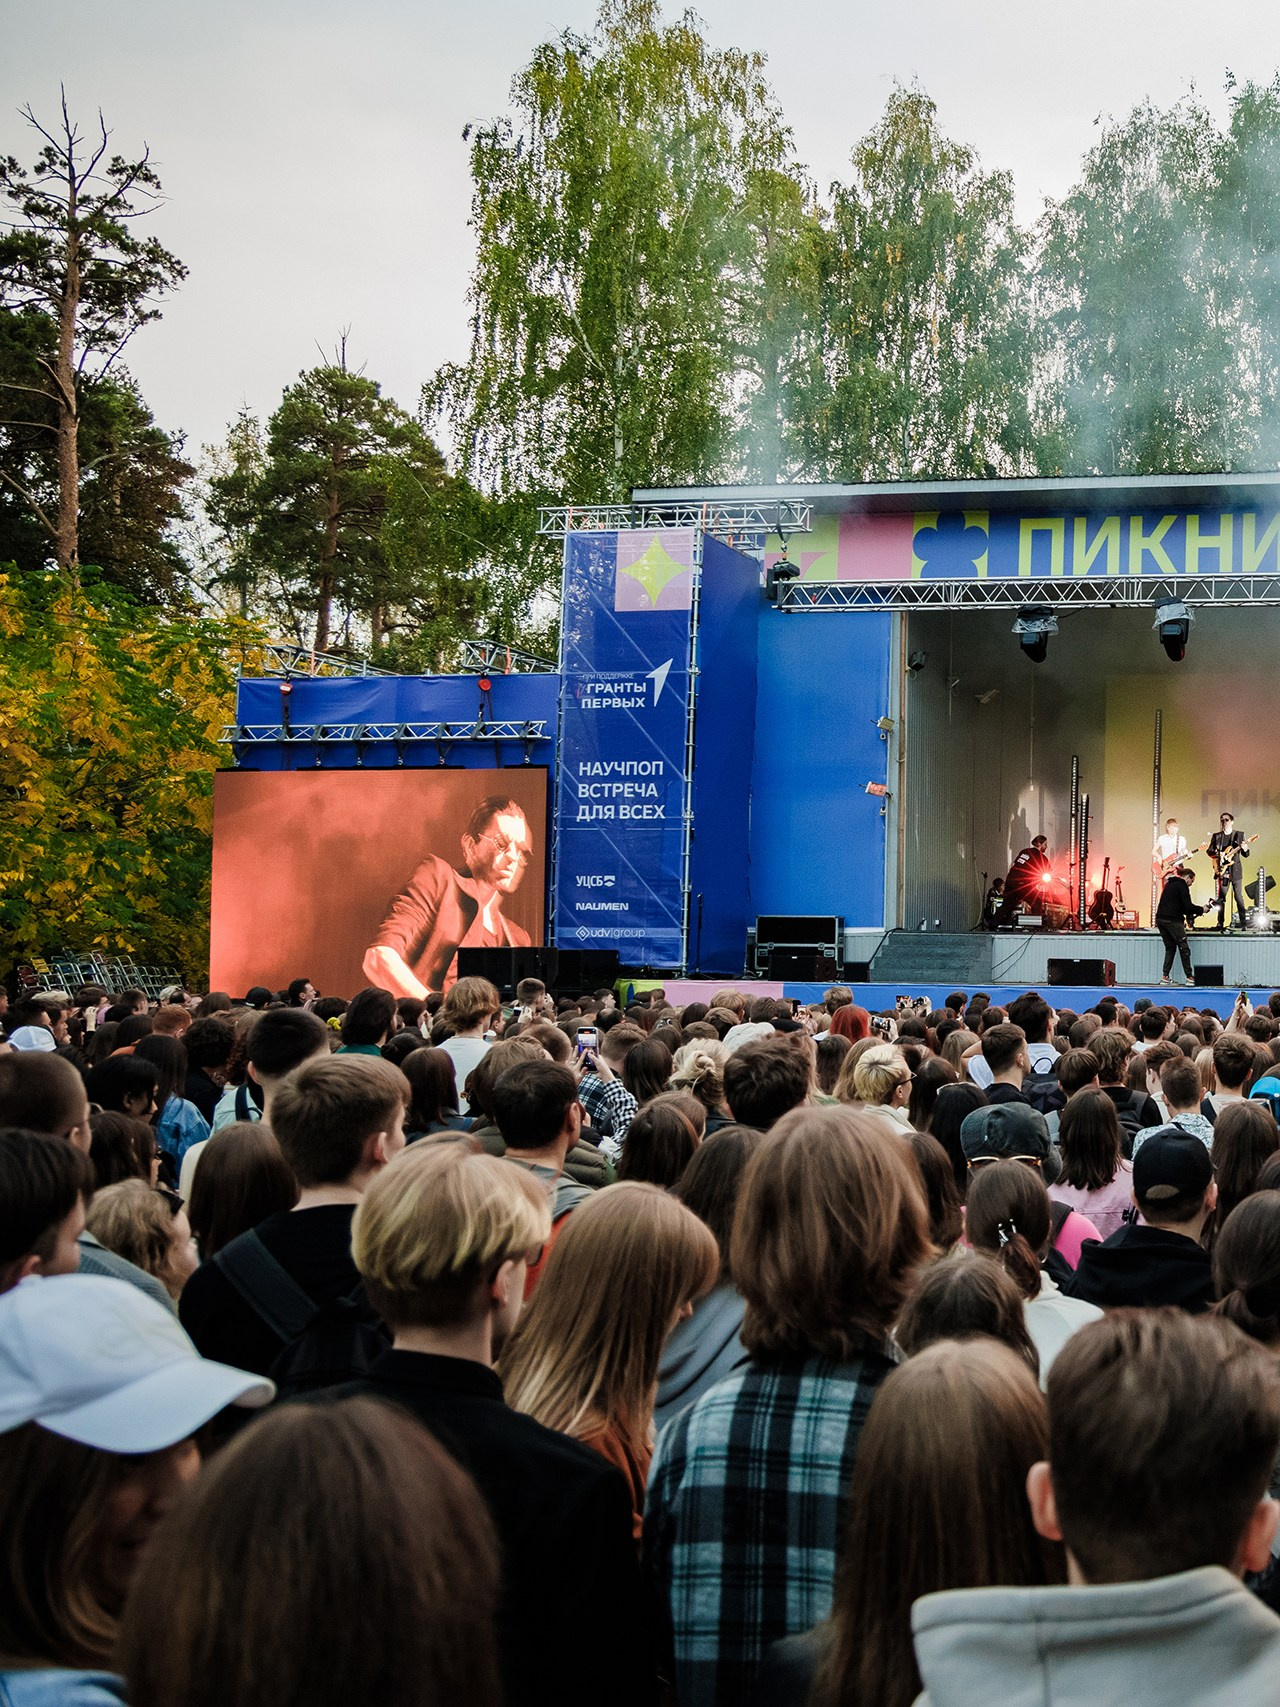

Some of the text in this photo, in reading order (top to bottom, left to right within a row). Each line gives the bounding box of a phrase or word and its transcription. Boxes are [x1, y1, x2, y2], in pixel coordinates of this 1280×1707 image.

[586, 682, 647, 694] ГРАНТЫ
[581, 697, 646, 709] ПЕРВЫХ
[579, 761, 664, 776] НАУЧПОП
[578, 783, 658, 798] ВСТРЕЧА
[576, 805, 665, 822] ДЛЯ ВСЕХ
[576, 875, 603, 888] УЦСБ
[575, 902, 629, 910] NAUMEN
